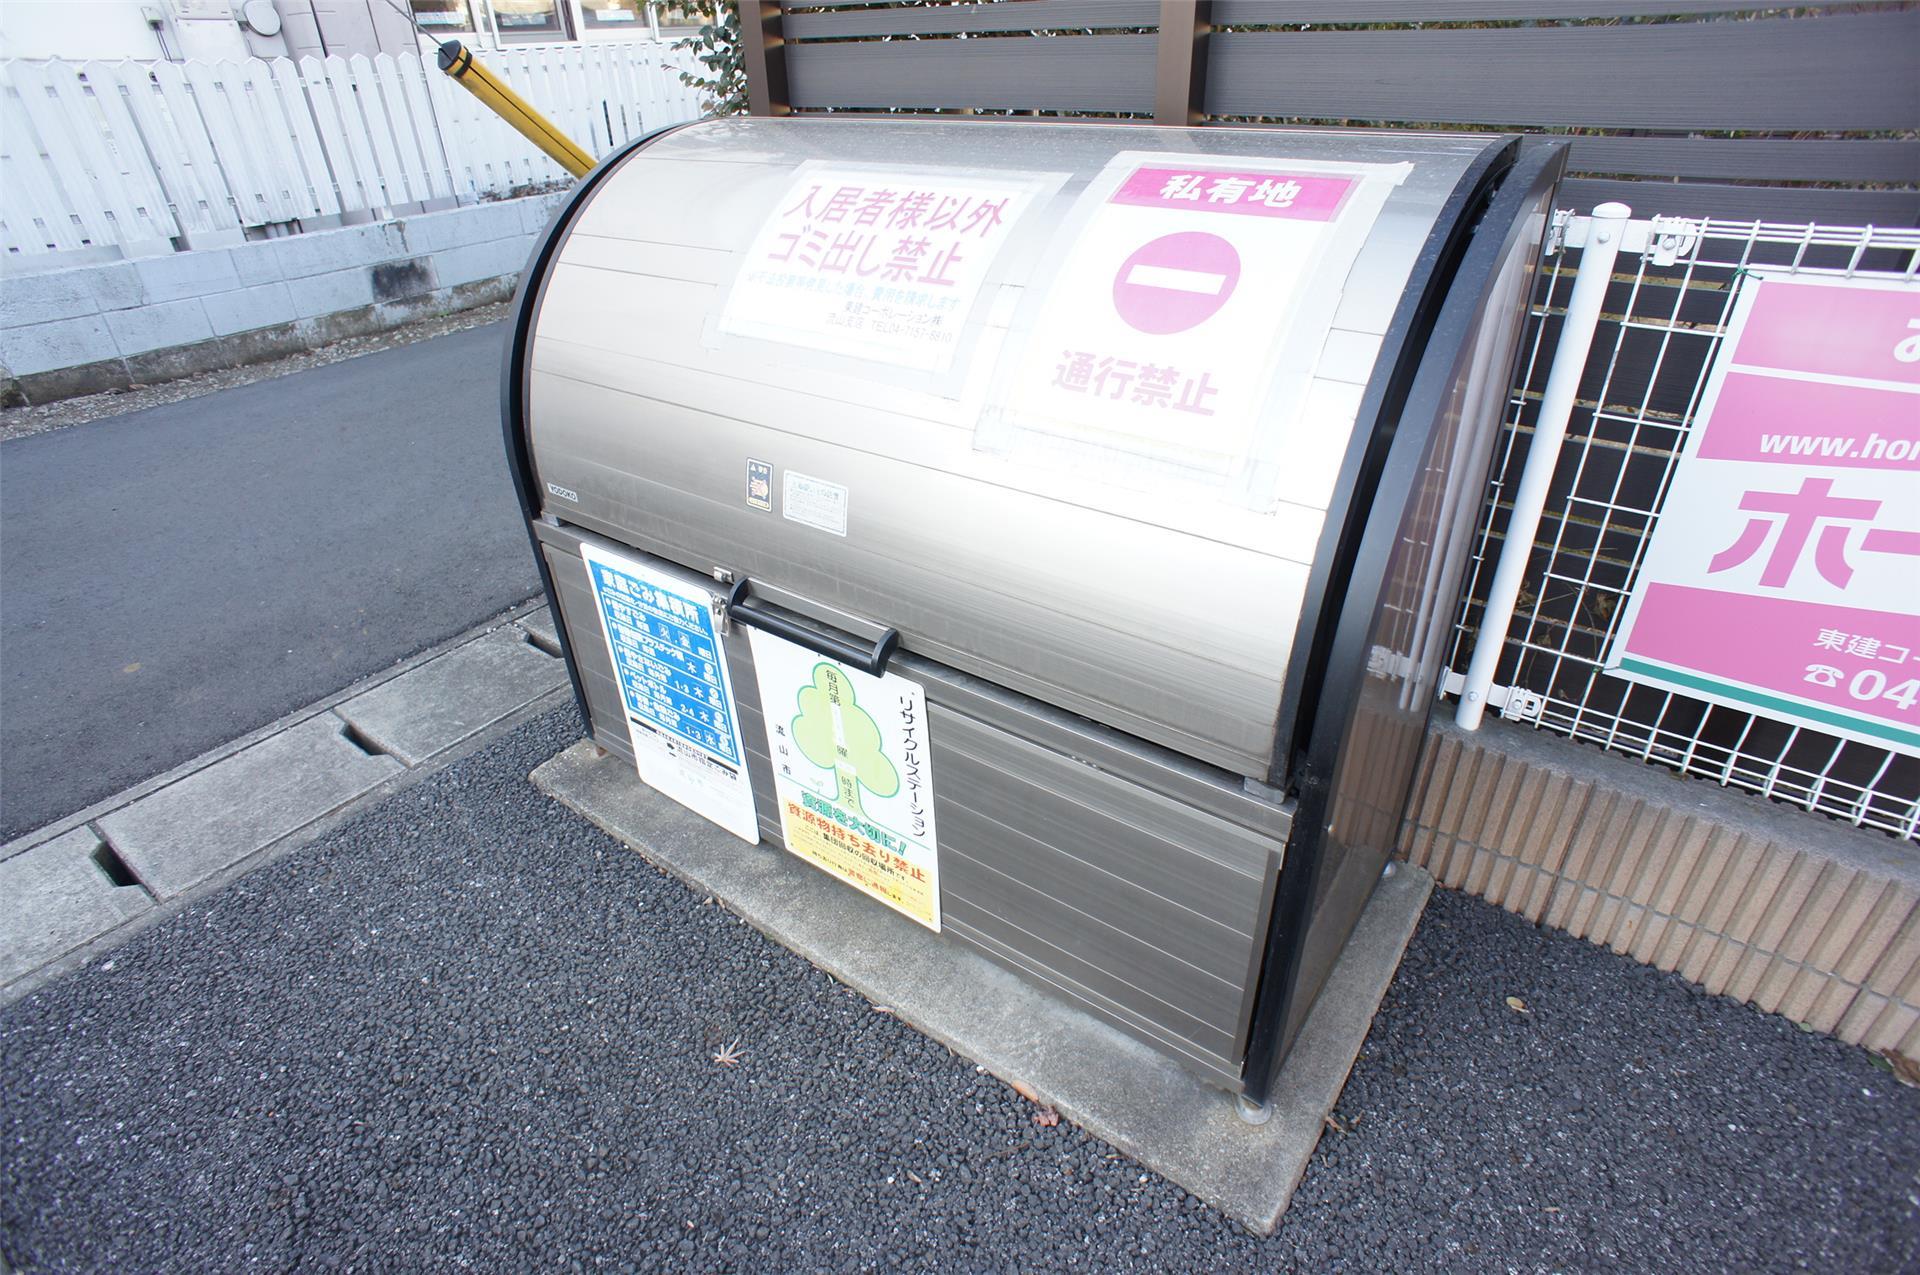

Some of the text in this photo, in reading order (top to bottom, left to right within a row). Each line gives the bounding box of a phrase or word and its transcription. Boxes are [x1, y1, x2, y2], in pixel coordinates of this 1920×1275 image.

[782, 184, 1011, 238] 入居者様以外
[1159, 173, 1303, 209] 私有地
[767, 224, 964, 287] ゴミ出し禁止
[1051, 349, 1219, 417] 通行禁止
[1760, 432, 1920, 461] www.ho
[775, 723, 793, 776] 流山市
[899, 695, 927, 838] リサイクルステーション
[788, 802, 926, 884] 資源物持ち去り禁止
